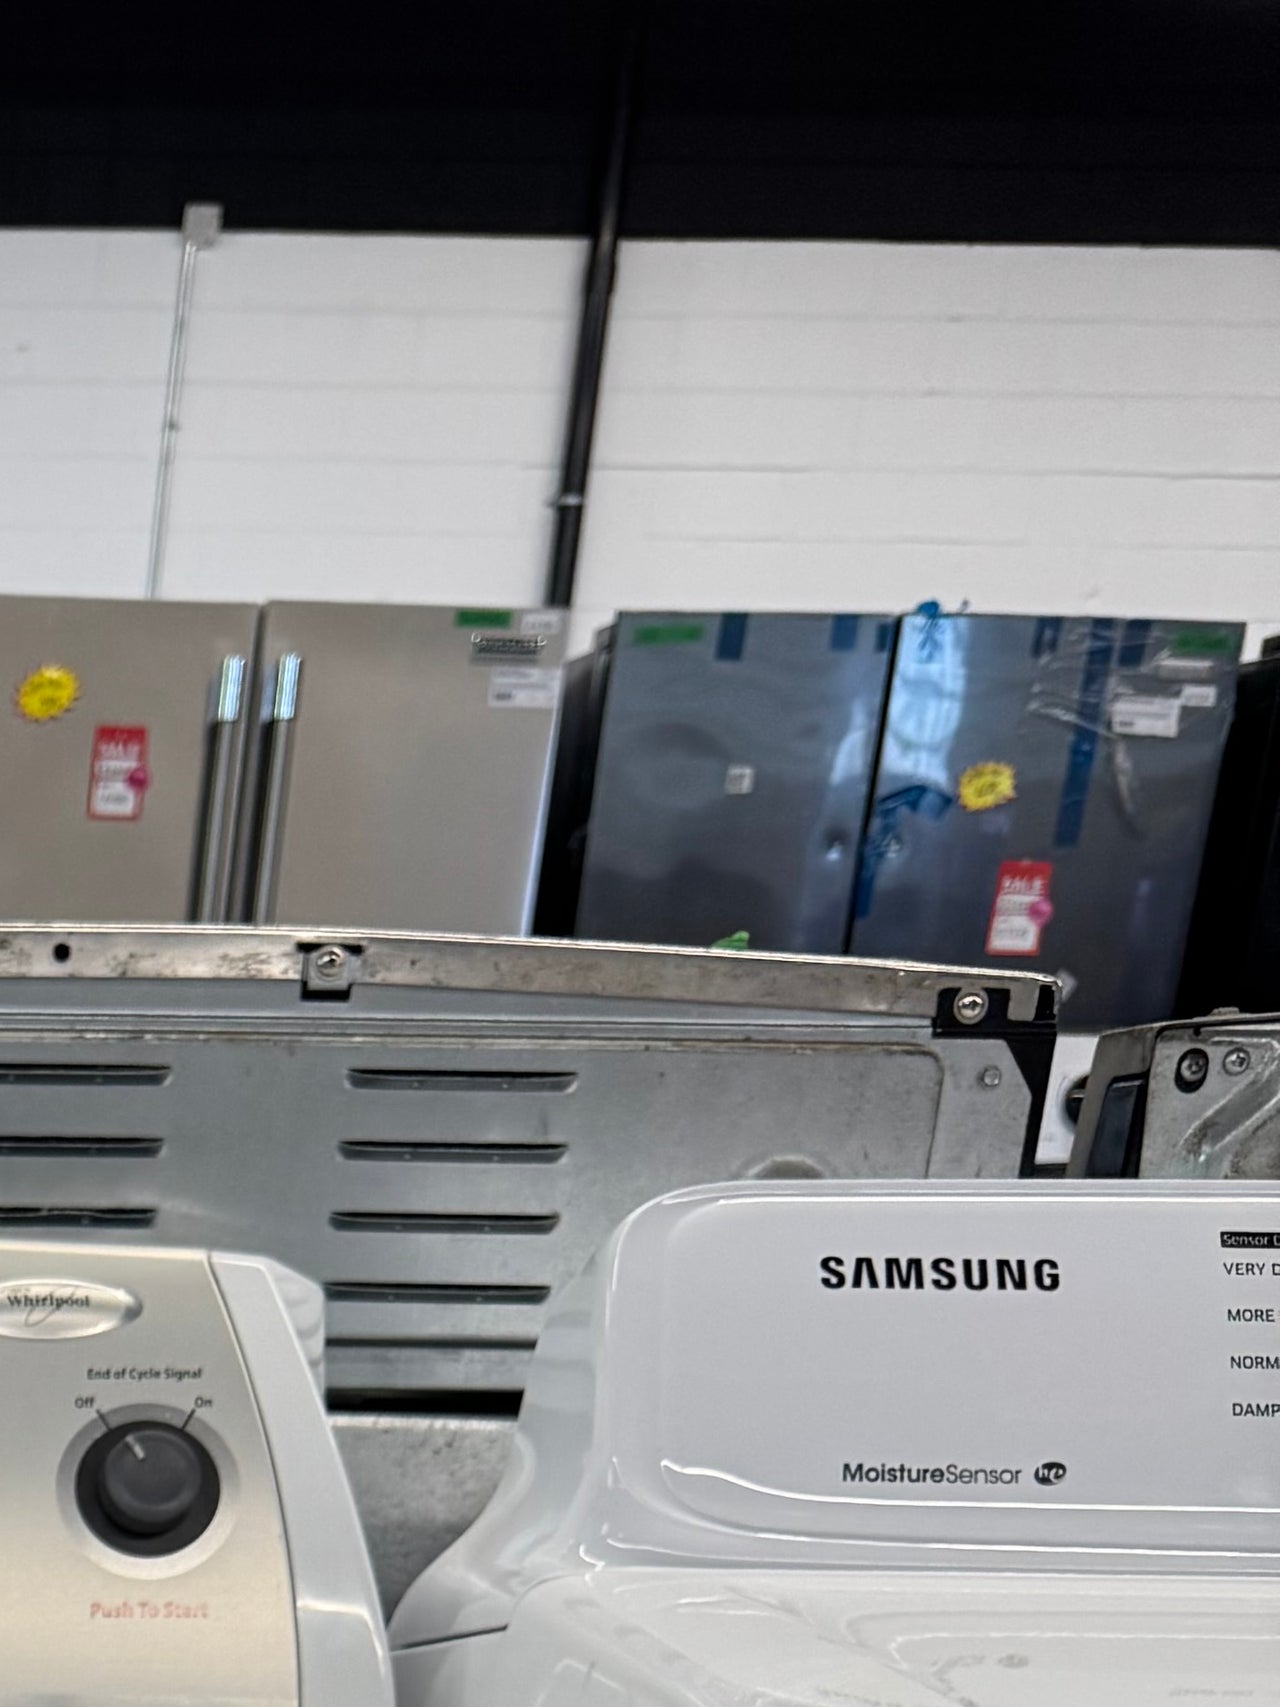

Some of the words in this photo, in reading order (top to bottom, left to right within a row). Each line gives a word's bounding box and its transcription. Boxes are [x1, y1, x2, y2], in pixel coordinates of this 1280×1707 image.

[1223, 1234, 1269, 1246] Sensor
[820, 1256, 1060, 1292] SAMSUNG
[1223, 1262, 1265, 1276] VERY
[7, 1292, 90, 1311] Whirlpool
[1227, 1308, 1275, 1322] MORE
[87, 1368, 111, 1380] End
[113, 1368, 126, 1380] of
[128, 1368, 161, 1382] Cycle
[163, 1368, 202, 1382] Signal
[74, 1396, 94, 1409] Off
[194, 1397, 212, 1408] On
[1232, 1402, 1280, 1417] DAMP
[842, 1462, 1023, 1485] MoistureSensor
[90, 1601, 135, 1619] Push
[138, 1602, 160, 1619] To
[162, 1601, 209, 1619] Start
